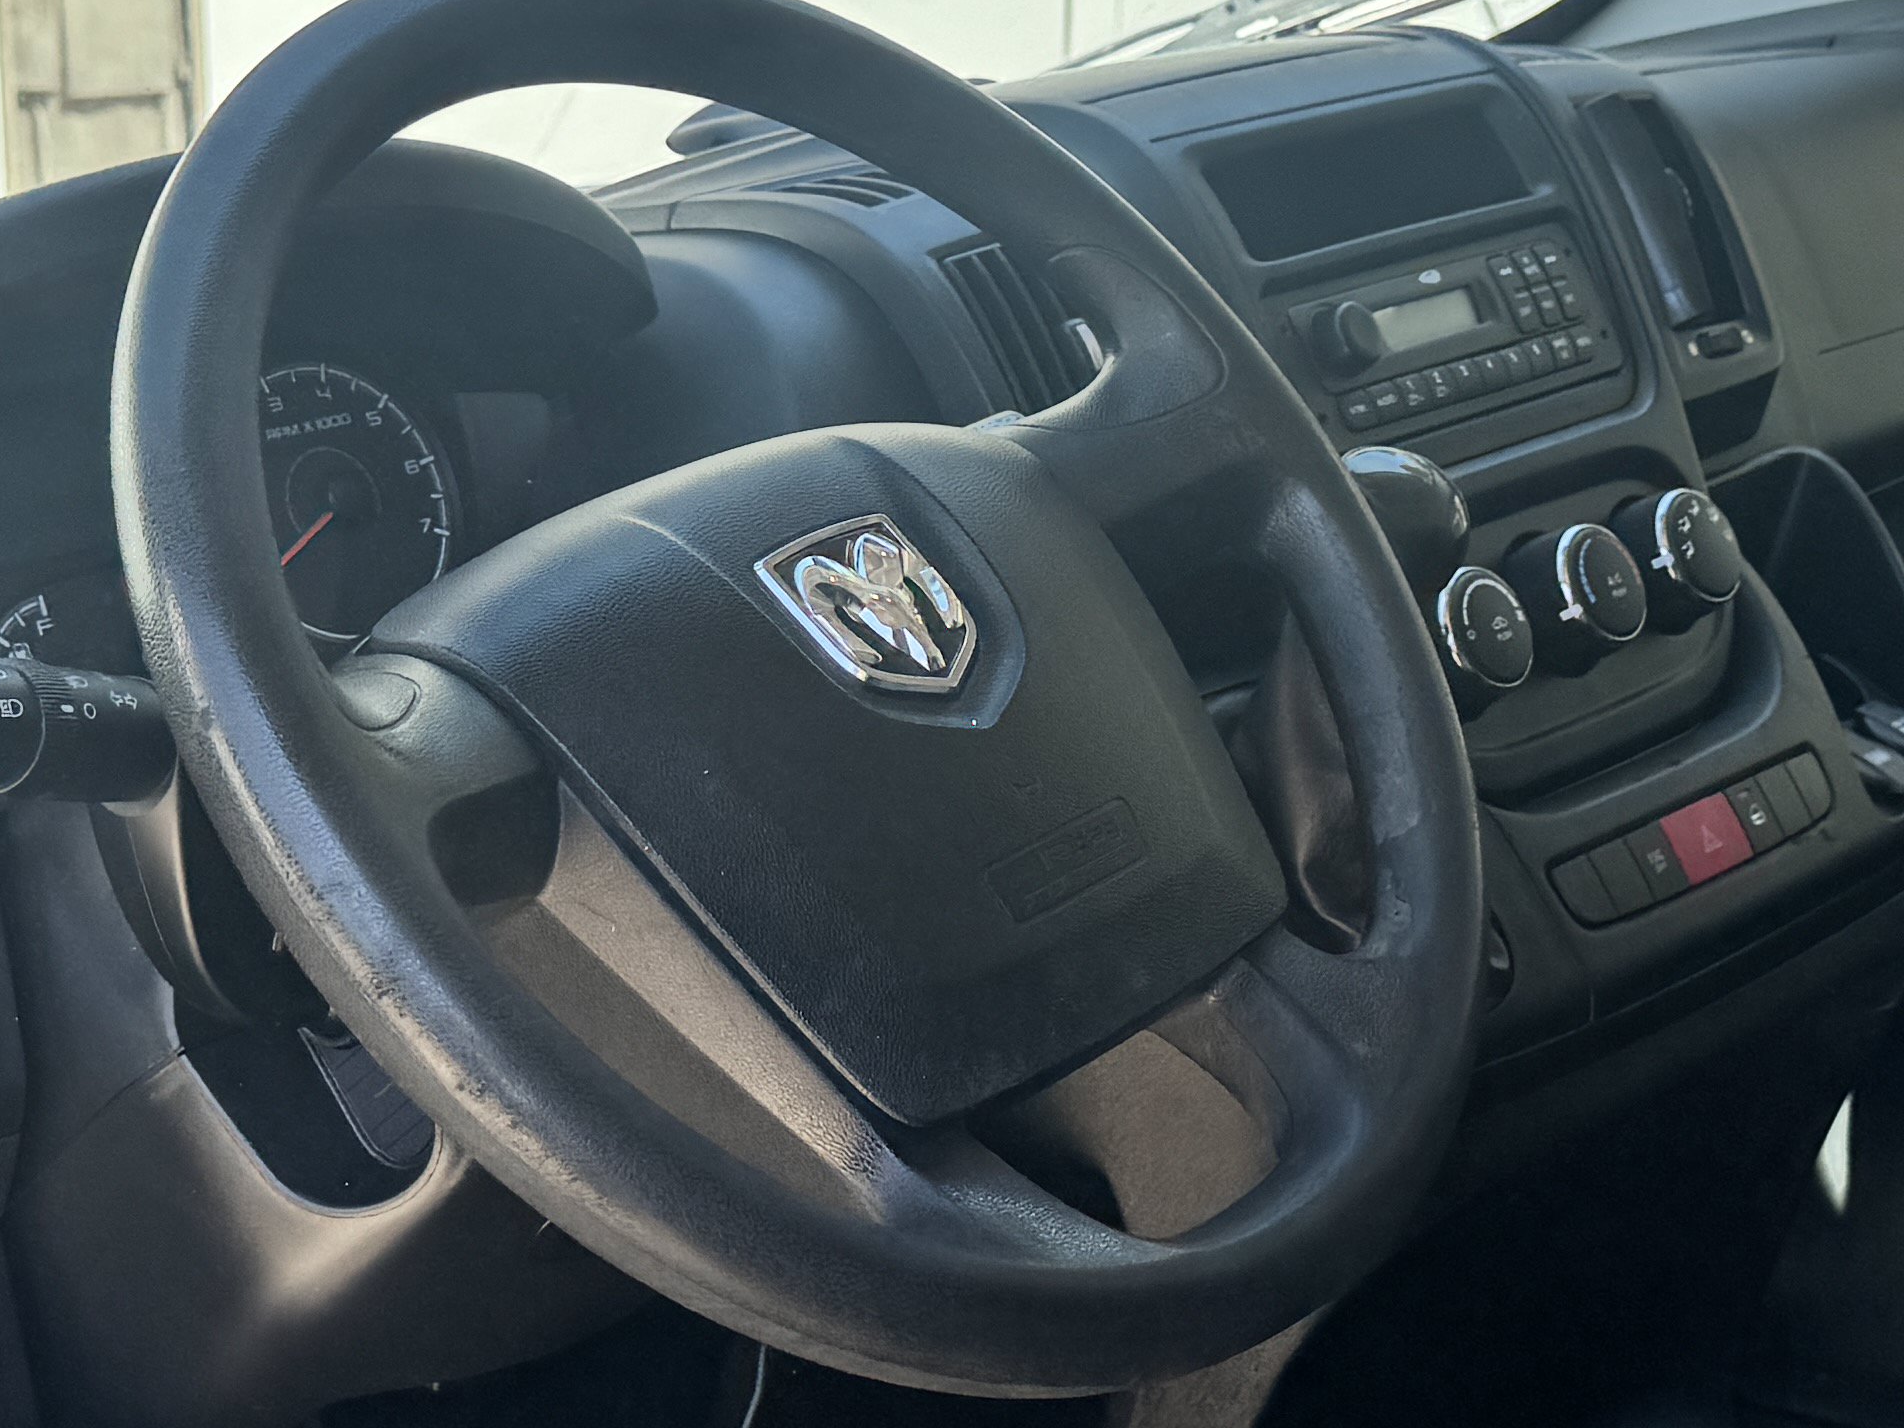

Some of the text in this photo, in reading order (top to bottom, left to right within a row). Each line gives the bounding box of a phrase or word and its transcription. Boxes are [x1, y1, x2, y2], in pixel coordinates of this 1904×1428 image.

[316, 386, 333, 400] 4
[267, 397, 284, 413] 3
[365, 410, 383, 427] 5
[404, 459, 420, 475] 6
[419, 517, 432, 534] 7
[37, 618, 54, 636] F
